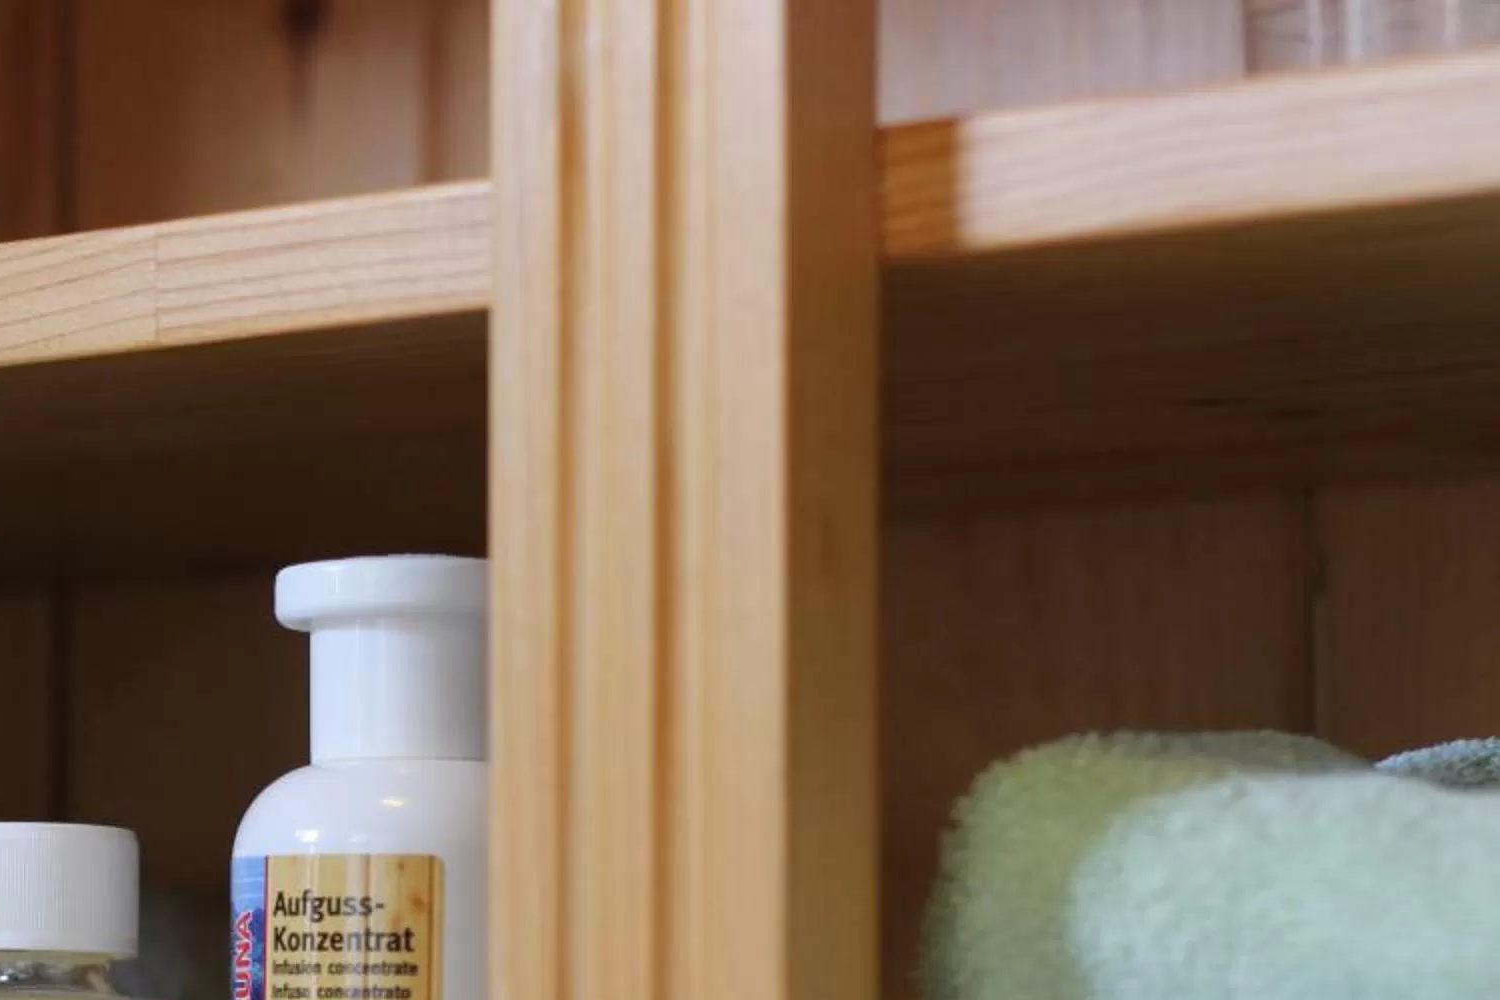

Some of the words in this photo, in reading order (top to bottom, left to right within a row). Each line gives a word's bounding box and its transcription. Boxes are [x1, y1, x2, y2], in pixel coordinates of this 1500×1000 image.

[273, 889, 385, 923] Aufguss-
[273, 926, 415, 952] Konzentrat
[272, 960, 322, 976] Infusion
[328, 961, 419, 977] concentrate
[317, 986, 411, 1000] concentrato
